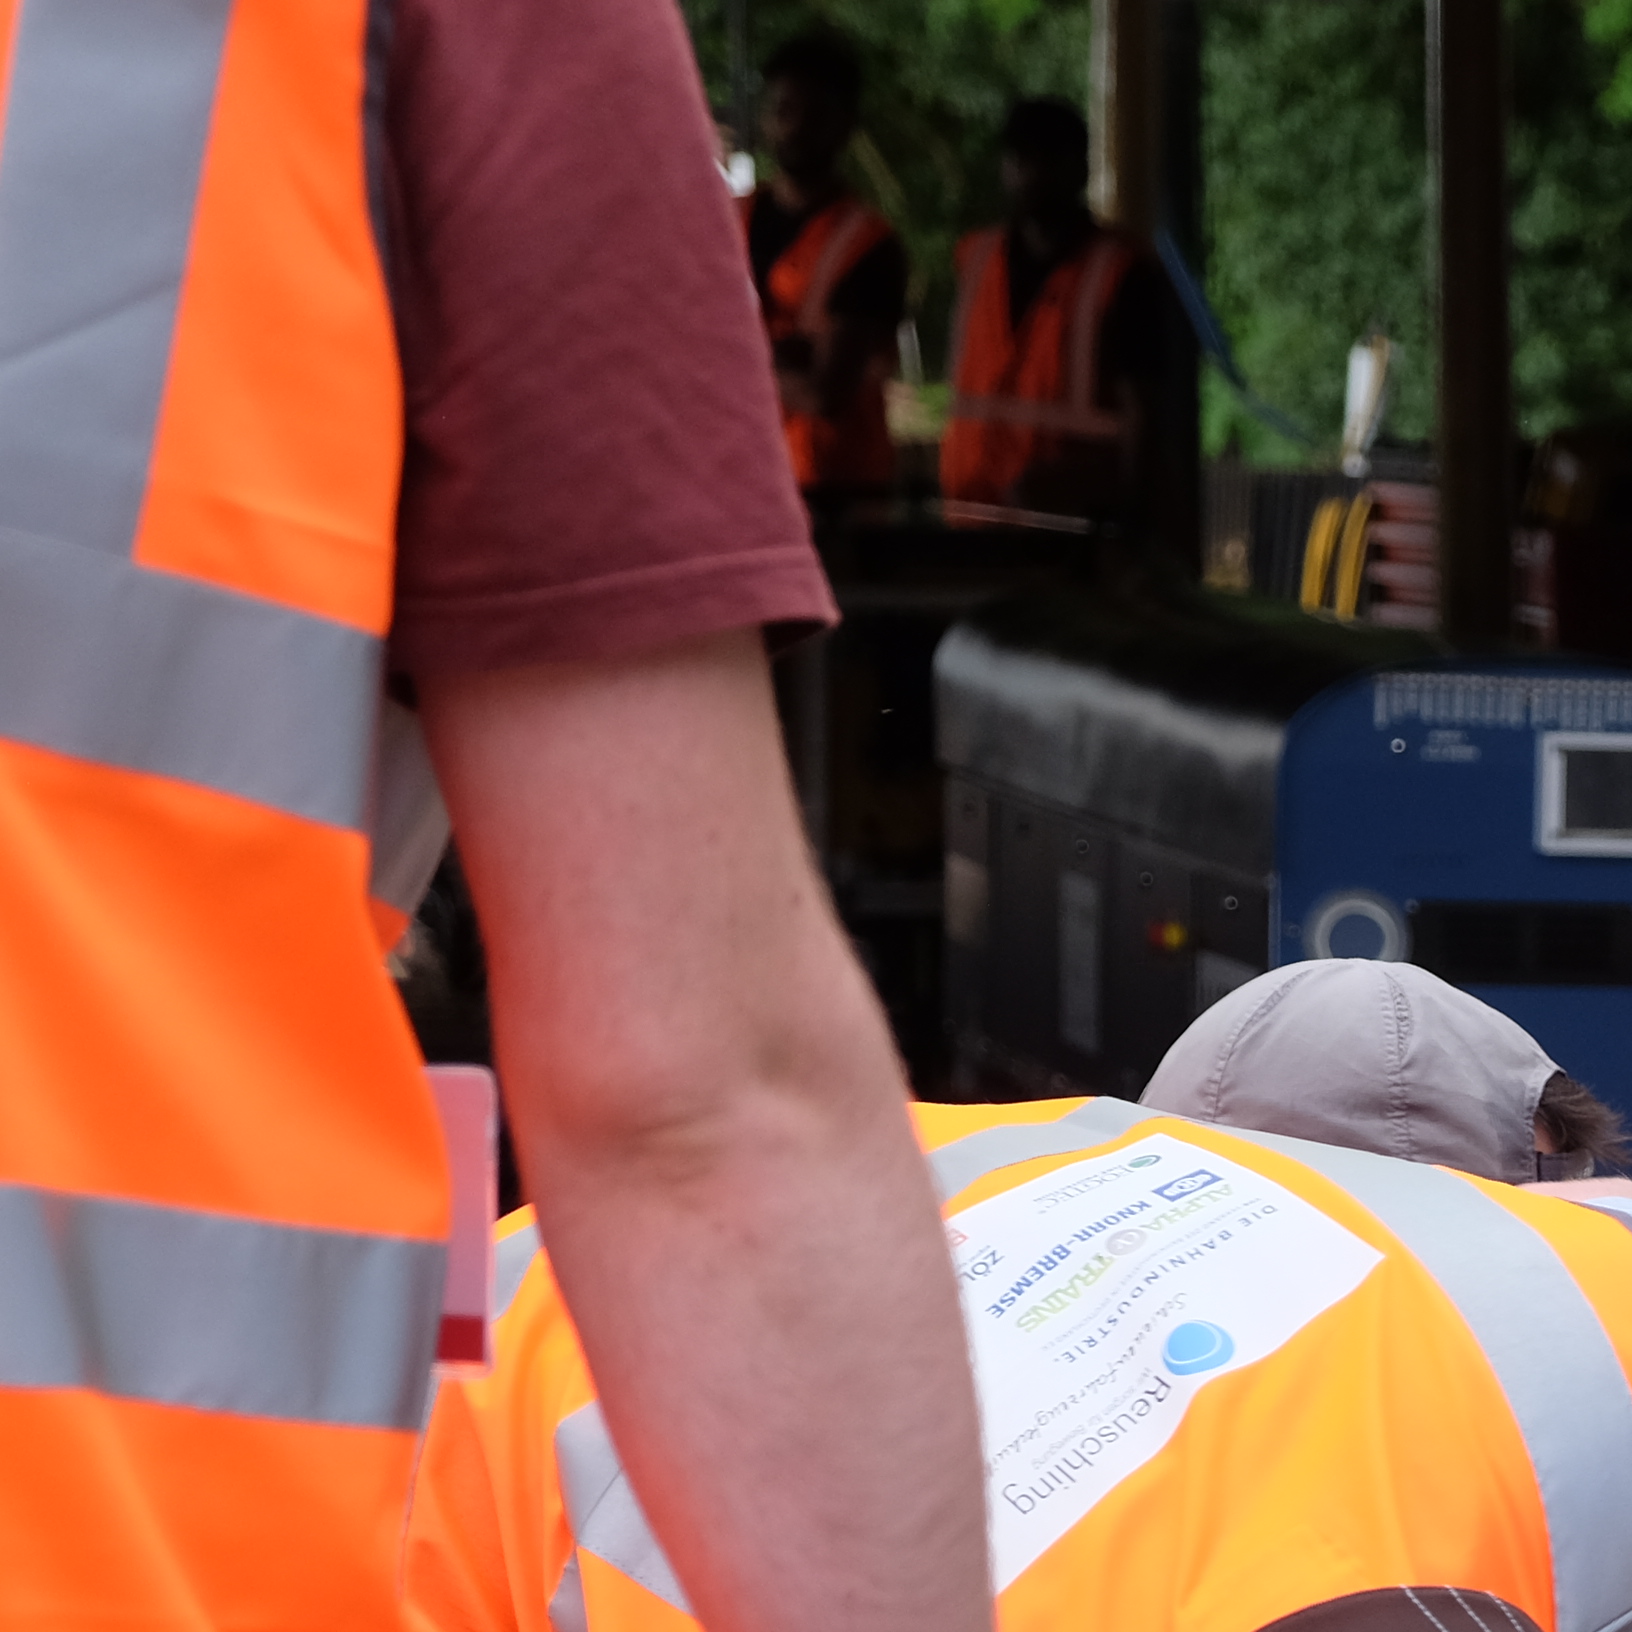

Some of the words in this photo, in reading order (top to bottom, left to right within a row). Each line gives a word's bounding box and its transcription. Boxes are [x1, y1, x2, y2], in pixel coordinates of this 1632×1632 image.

[1141, 1183, 1235, 1233] ALPHA
[1238, 1204, 1279, 1230] DIE
[962, 1245, 1005, 1284] ZÖL
[985, 1200, 1150, 1320] KNORR-BREMSE
[1015, 1252, 1124, 1333] TRAINS
[1052, 1229, 1235, 1365] BAHNINDUSTRIE.
[986, 1291, 1189, 1478] Schienenfahrzeugtechni
[1001, 1374, 1172, 1516] Reuschling
